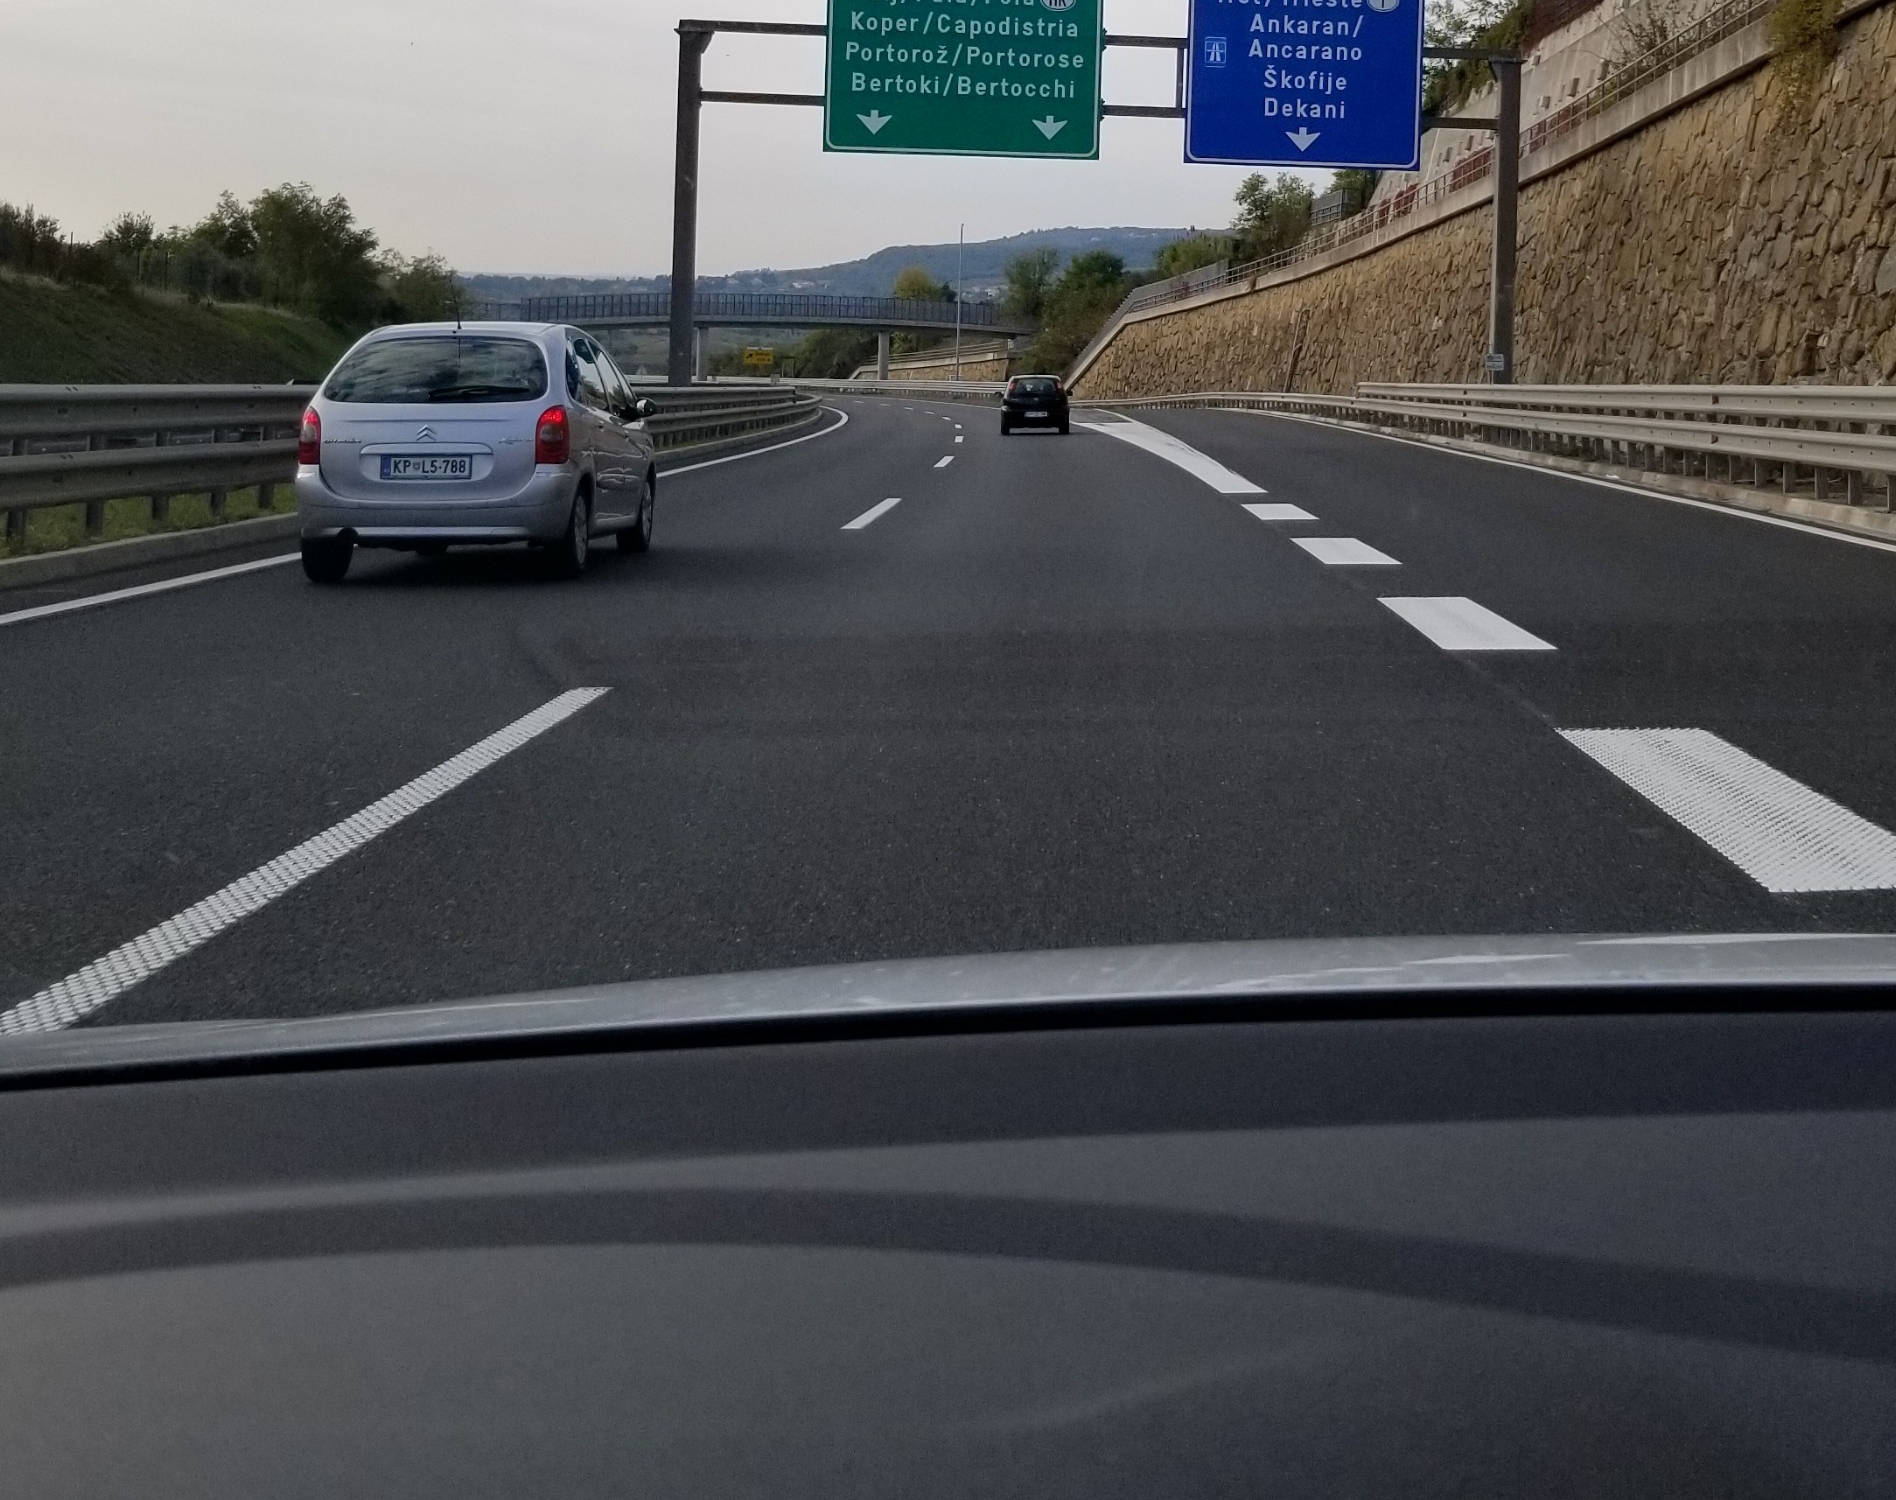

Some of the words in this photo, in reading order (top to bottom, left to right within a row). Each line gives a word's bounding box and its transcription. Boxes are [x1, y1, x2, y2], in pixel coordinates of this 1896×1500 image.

[851, 11, 1078, 40] Koper/Capodistria
[1249, 13, 1364, 38] Ankaran/
[845, 41, 1084, 68] Portorož/Portorose
[1248, 38, 1362, 61] Ancarano
[851, 72, 1074, 98] Bertoki/Bertocchi
[1263, 64, 1347, 95] Škofije
[1264, 97, 1345, 119] Dekani
[393, 459, 412, 474] KP
